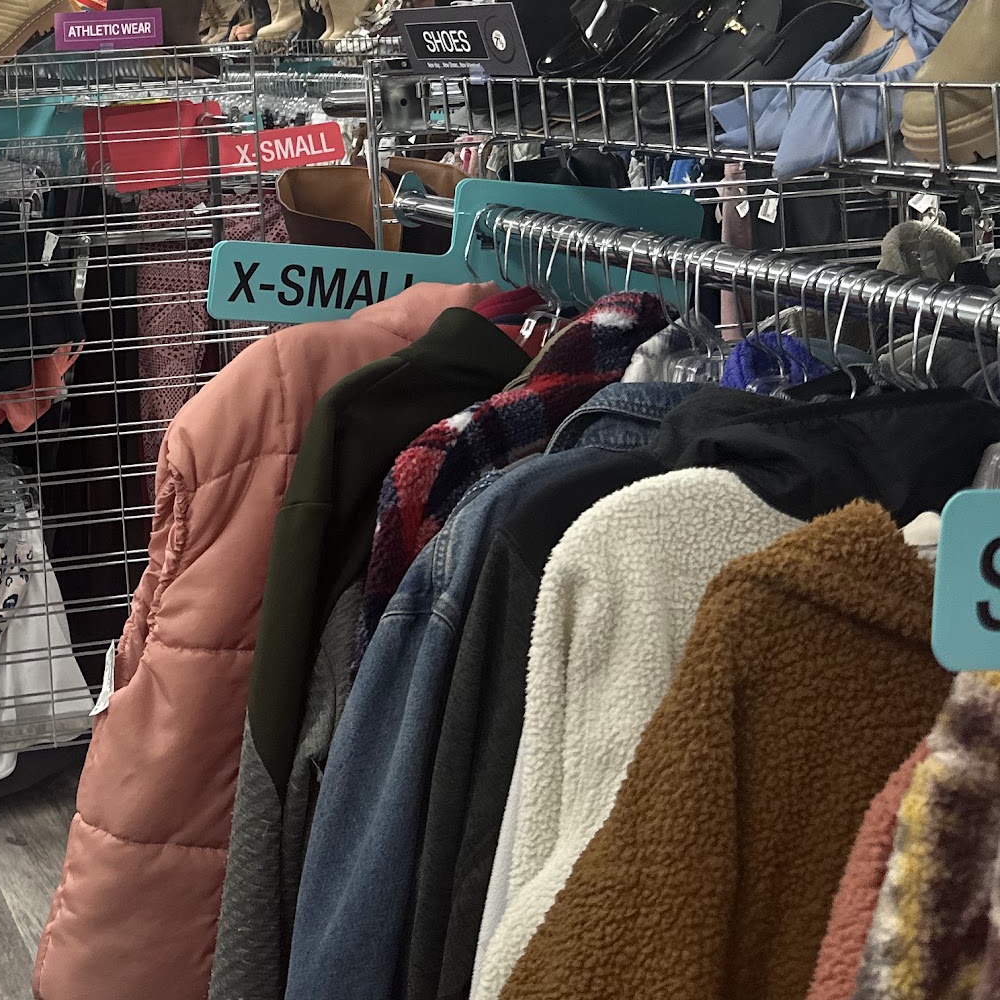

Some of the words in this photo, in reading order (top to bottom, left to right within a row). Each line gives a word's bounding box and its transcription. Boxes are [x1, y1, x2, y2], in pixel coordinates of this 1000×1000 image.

[68, 24, 119, 38] ATHLETIC
[121, 21, 151, 34] WEAR
[422, 30, 471, 53] SHOES
[235, 131, 335, 164] X-SMALL
